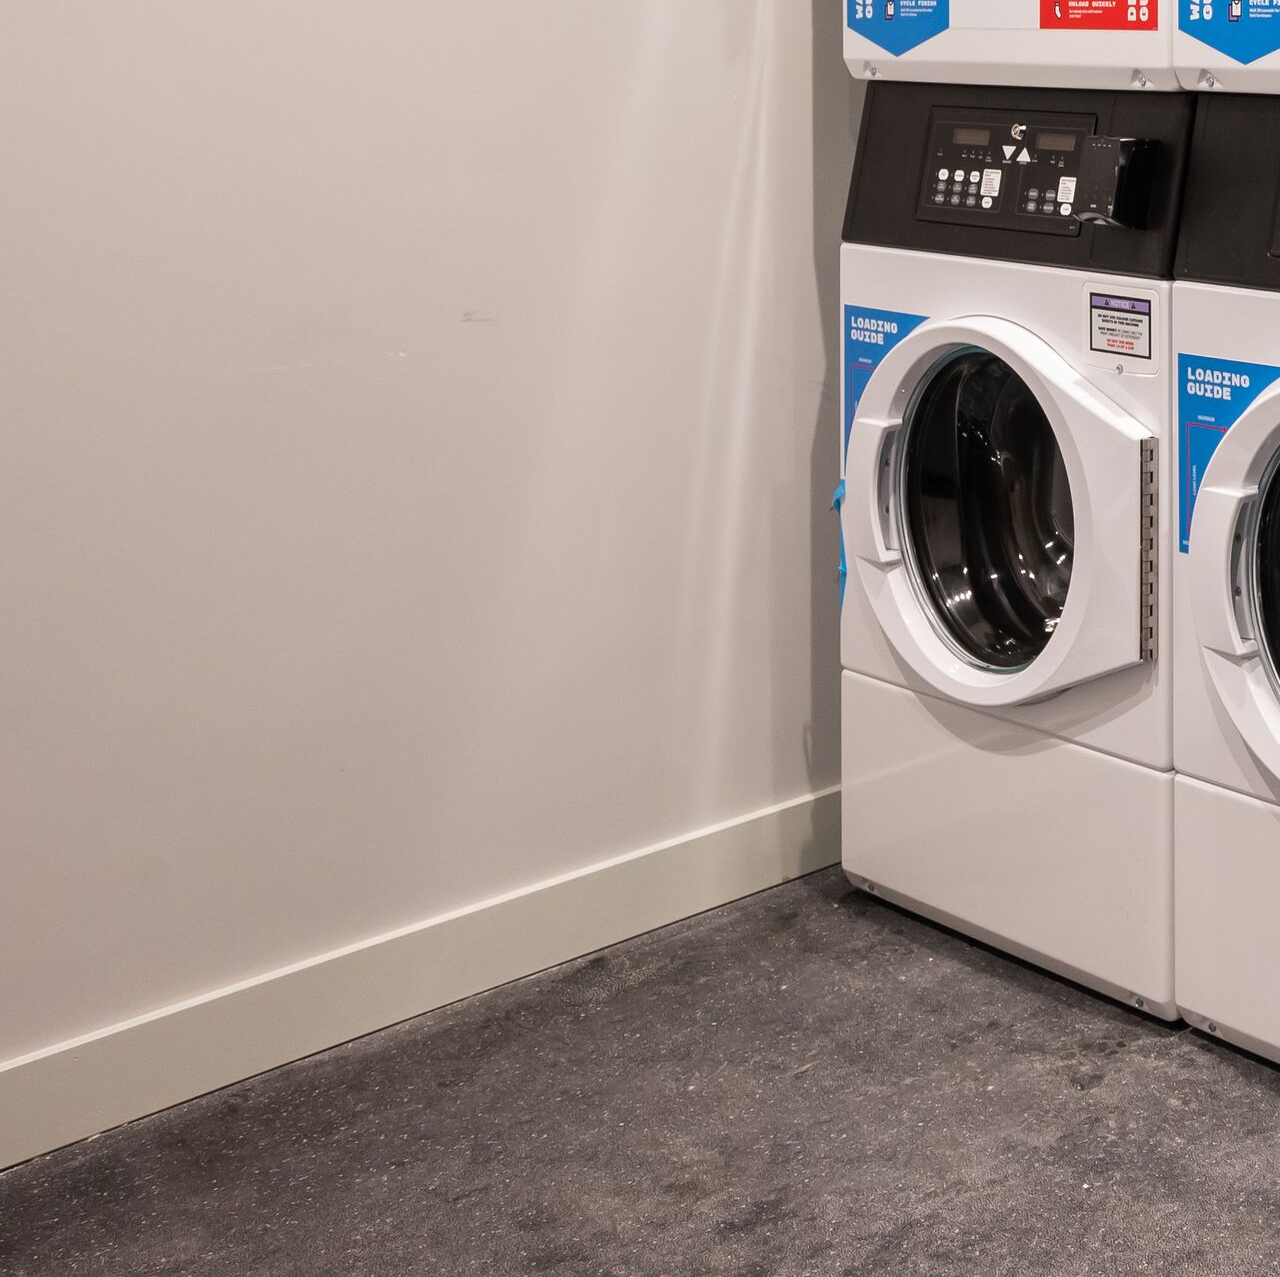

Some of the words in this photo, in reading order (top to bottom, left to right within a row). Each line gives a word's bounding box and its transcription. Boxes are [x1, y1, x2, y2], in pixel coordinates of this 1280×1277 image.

[851, 316, 897, 333] LOADING
[850, 329, 883, 344] GUIDE
[1187, 367, 1249, 387] LOADING
[1187, 382, 1231, 400] GUIDE
